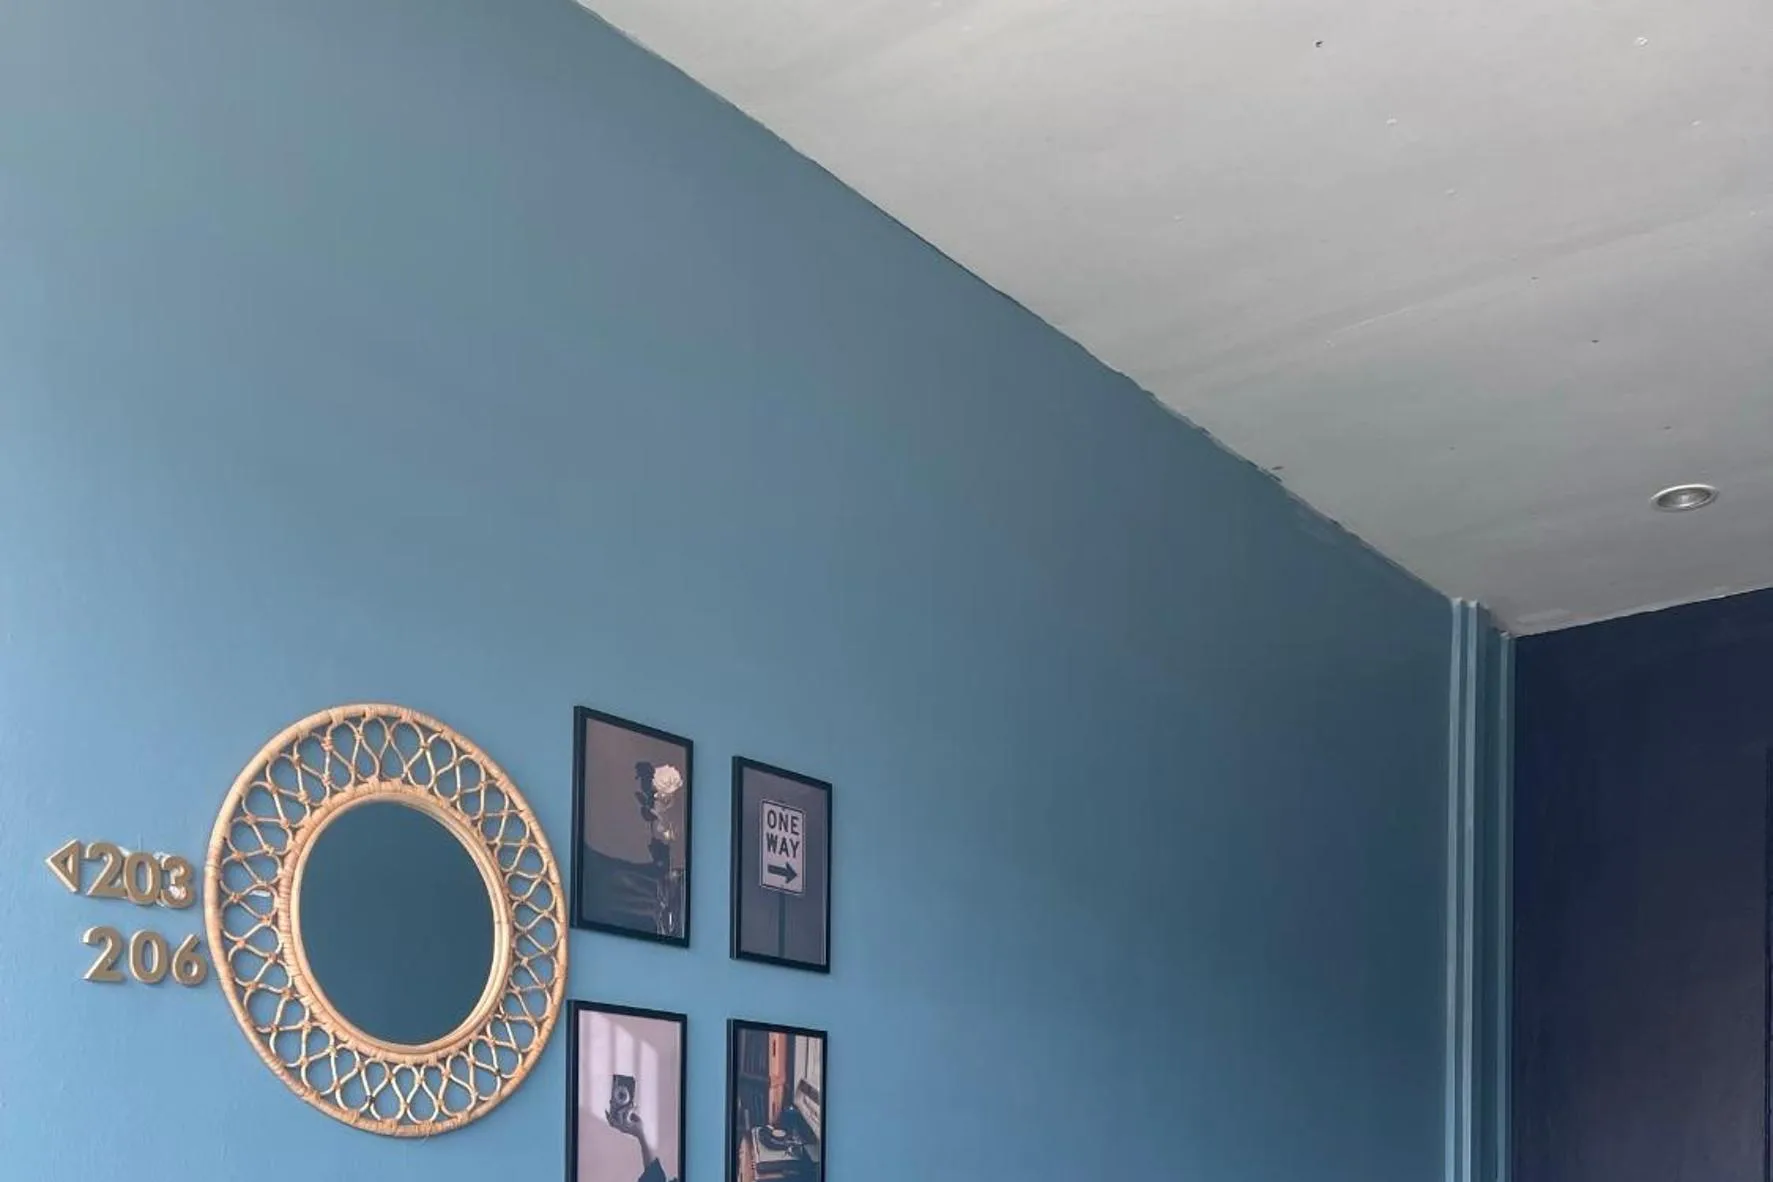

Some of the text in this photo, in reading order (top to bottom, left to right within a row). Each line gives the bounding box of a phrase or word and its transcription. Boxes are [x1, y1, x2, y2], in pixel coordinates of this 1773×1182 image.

[767, 809, 800, 836] ONE
[766, 832, 800, 859] WAY
[85, 841, 195, 908] 203
[82, 926, 207, 985] 206
